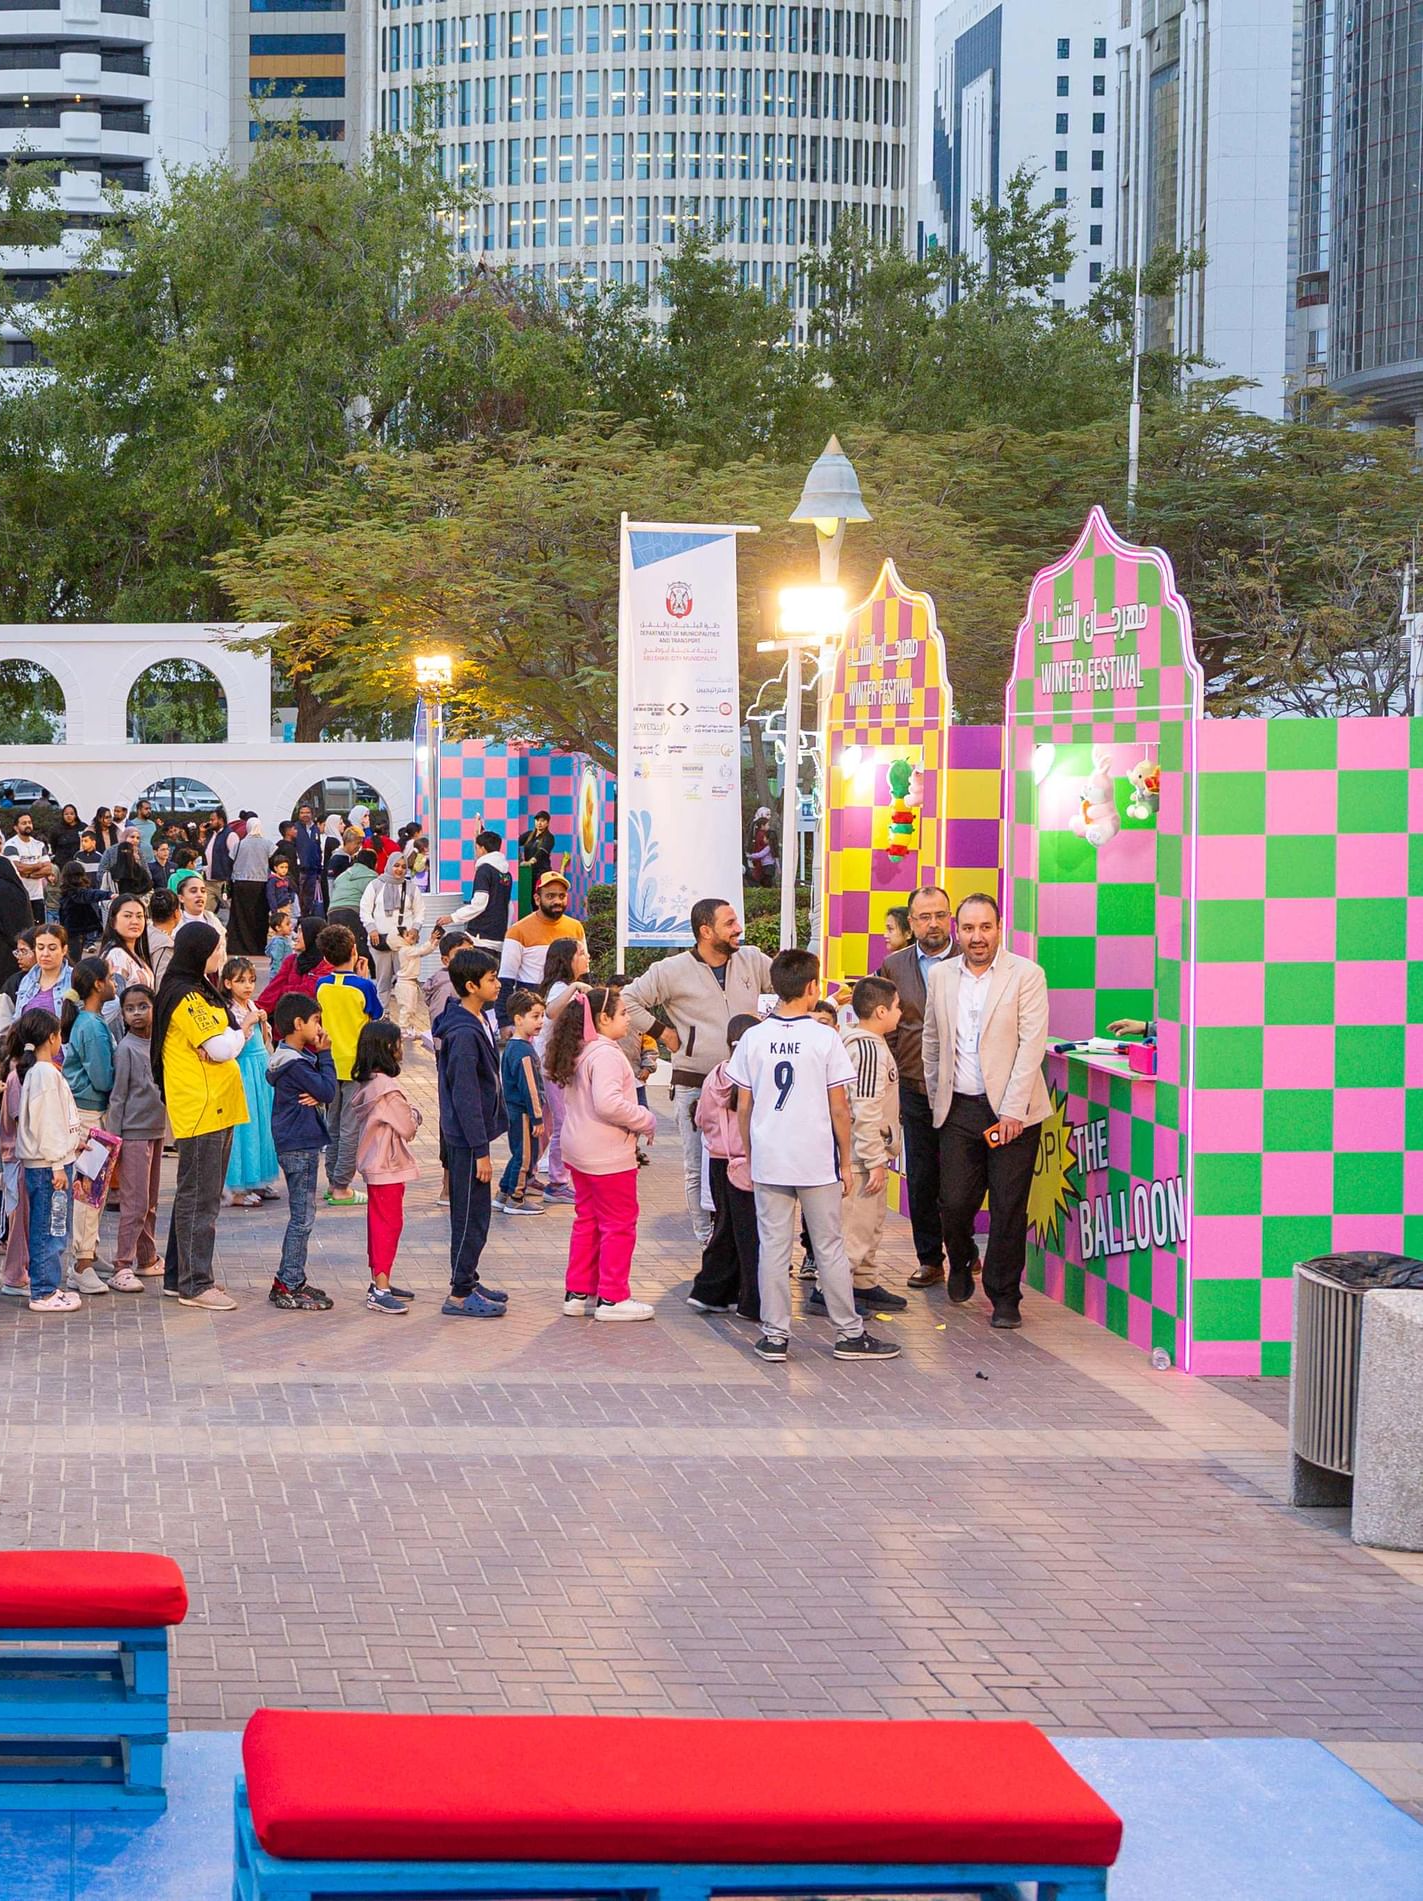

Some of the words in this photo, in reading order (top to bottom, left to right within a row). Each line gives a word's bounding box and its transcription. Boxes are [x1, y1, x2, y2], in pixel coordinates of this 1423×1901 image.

[1038, 597, 1080, 645] الشتاء
[1083, 597, 1149, 644] مهرجان
[848, 680, 877, 707] WINTER
[878, 677, 914, 705] FESTIVAL
[1040, 659, 1084, 695] WINTER
[1087, 652, 1144, 692] FESTIVAL
[770, 1042, 802, 1054] KANE
[774, 1060, 795, 1111] 9
[1033, 1128, 1062, 1177] OP!
[1073, 1118, 1109, 1176] THE
[1078, 1175, 1187, 1261] BALLOON
